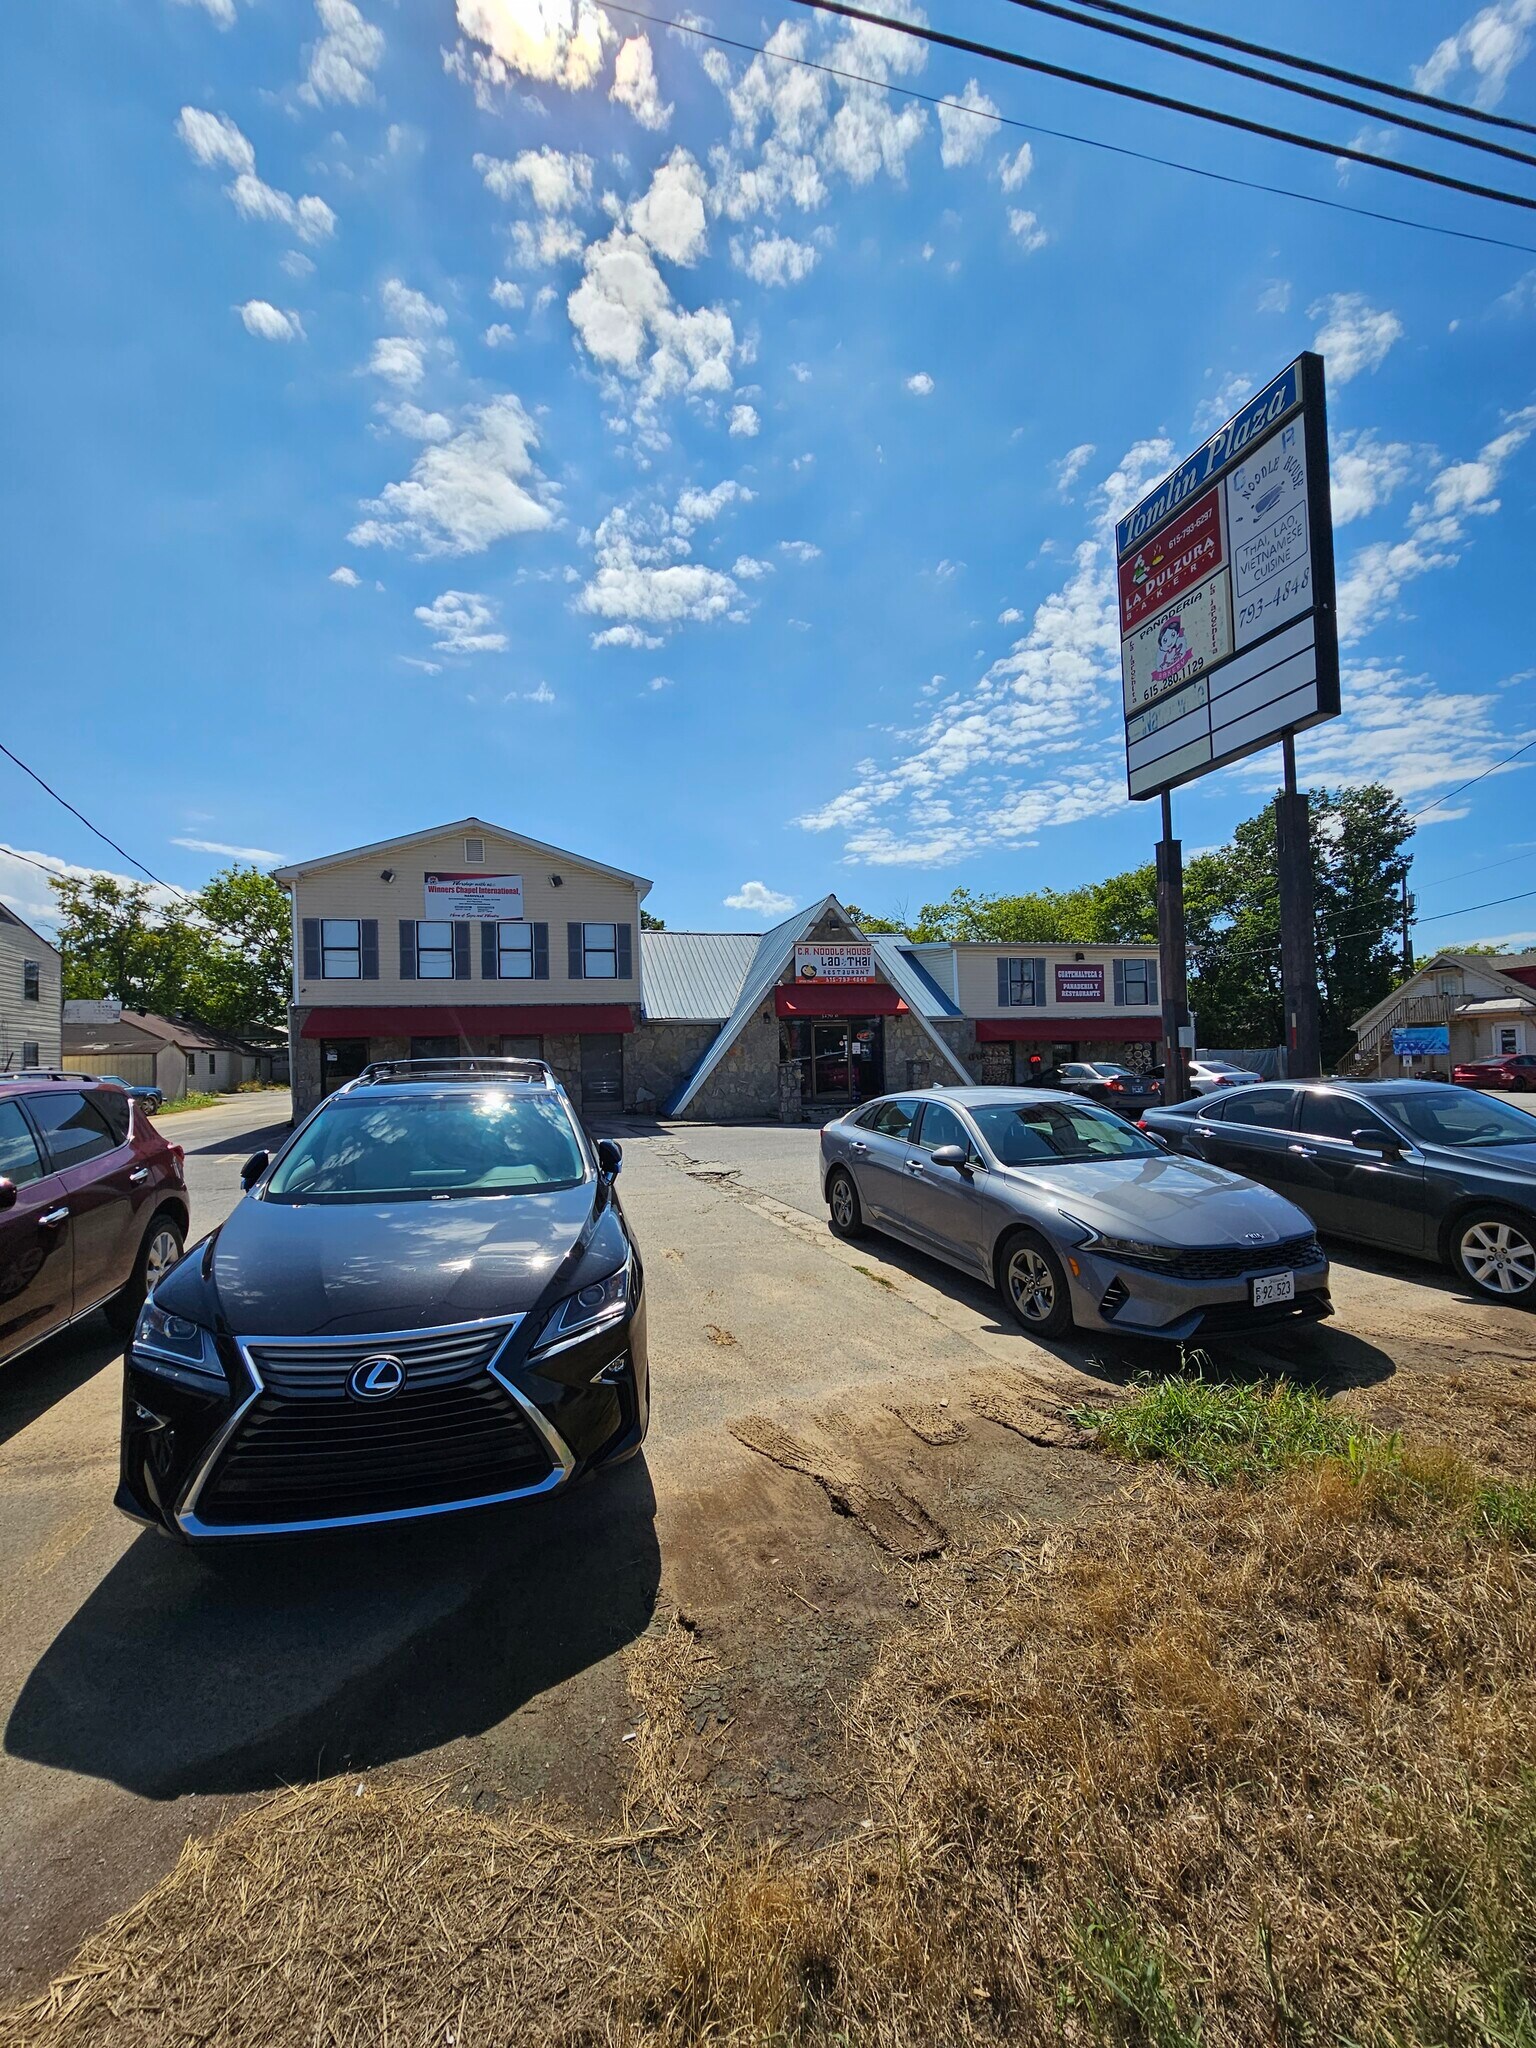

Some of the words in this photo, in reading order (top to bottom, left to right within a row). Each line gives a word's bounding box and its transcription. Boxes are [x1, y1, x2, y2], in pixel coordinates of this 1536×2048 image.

[1124, 467, 1197, 547] Tomlin
[1202, 385, 1287, 479] Plaza
[1242, 456, 1280, 500] NOODLE
[1283, 455, 1304, 491] HOUSE
[1168, 508, 1213, 549] 615-793-6297
[1240, 522, 1303, 575] VIETNAMESE
[1243, 534, 1271, 558] THAI,
[1273, 515, 1299, 538] LAO,
[1125, 593, 1142, 612] LA
[1145, 537, 1215, 596] DULZURA
[1253, 548, 1291, 581] CUISINE
[1139, 591, 1203, 641] PANADERIA
[1238, 566, 1310, 629] 793-4848
[1143, 656, 1204, 701] 615.280.1129
[1158, 659, 1186, 680] BAKERY
[428, 885, 455, 894] Winners
[455, 886, 478, 894] Chapel
[797, 947, 812, 956] C.R.
[1098, 970, 1103, 978] 2
[1263, 1285, 1273, 1299] 92
[1276, 1280, 1291, 1296] 523
